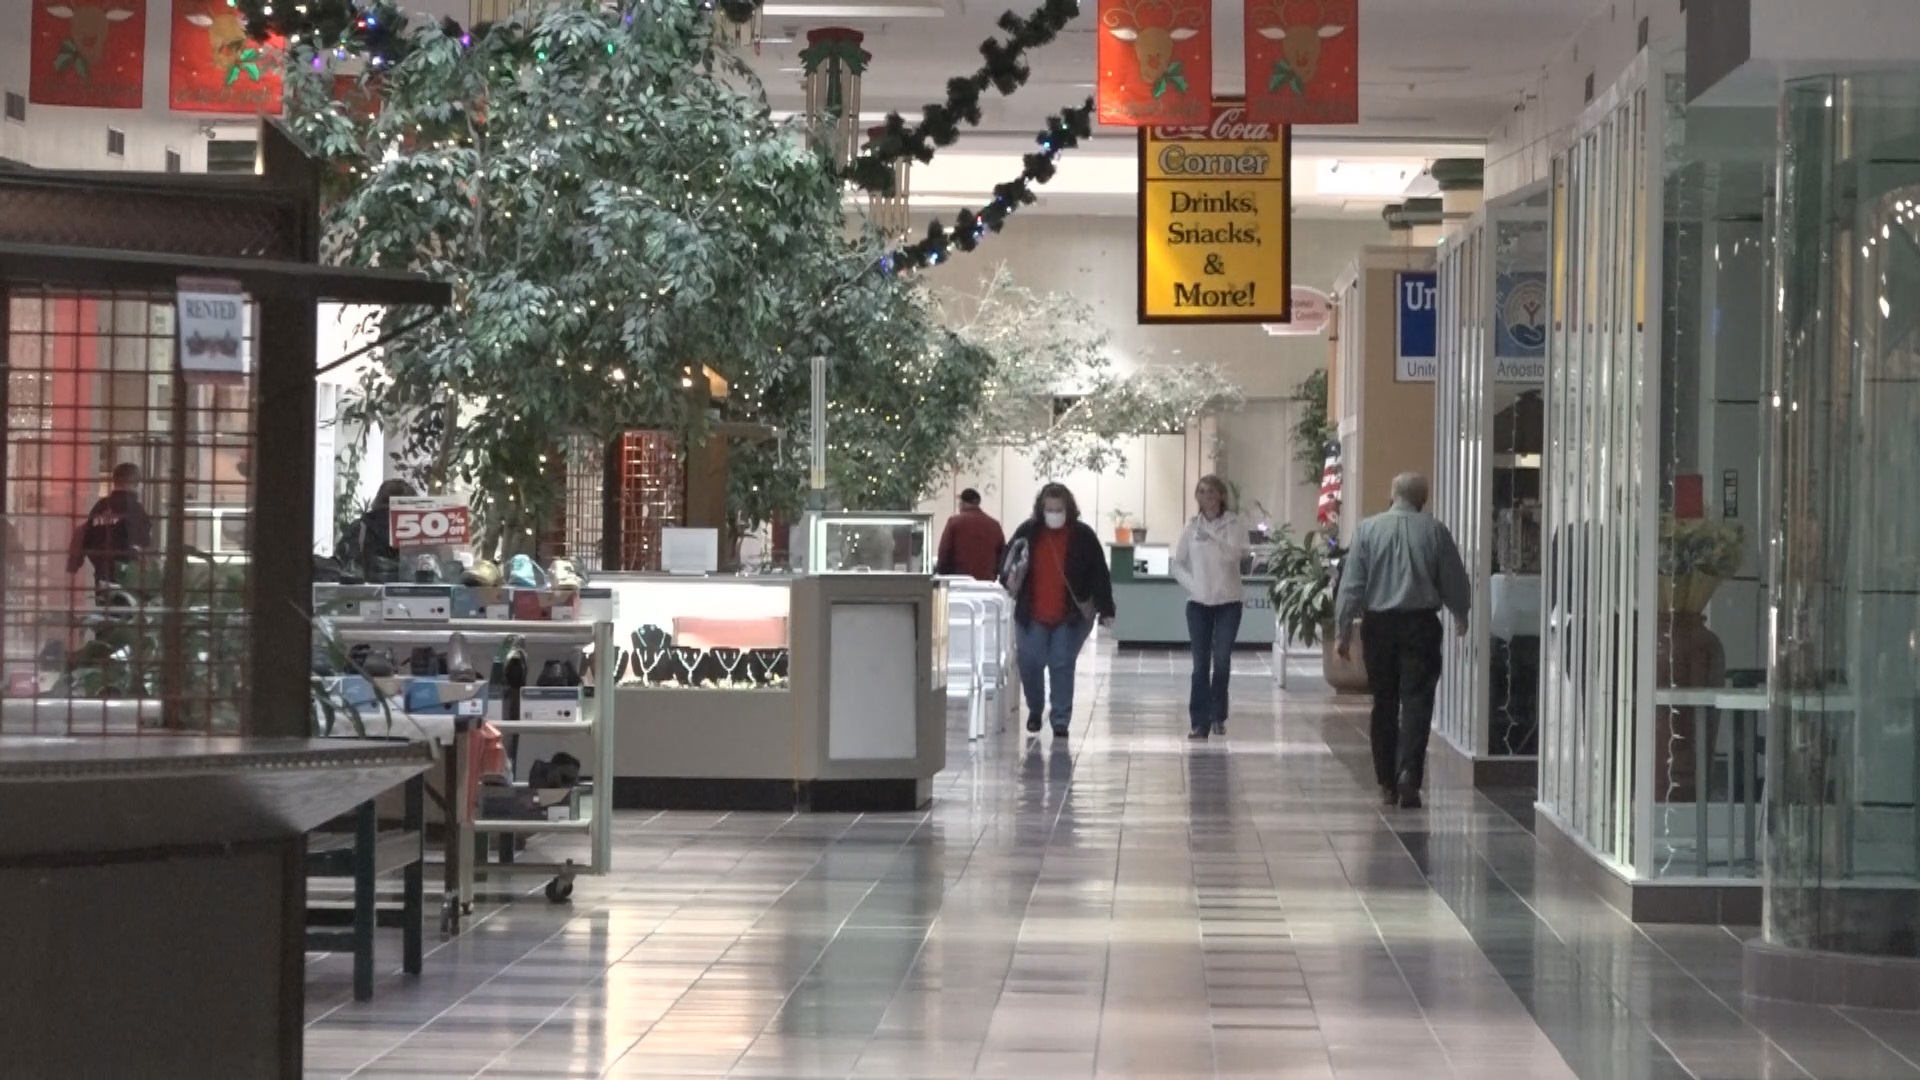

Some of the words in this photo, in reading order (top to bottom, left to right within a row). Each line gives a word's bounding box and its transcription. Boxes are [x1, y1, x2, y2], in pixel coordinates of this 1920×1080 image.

[1159, 144, 1269, 175] Corner
[1170, 190, 1258, 215] Drinks,
[1168, 222, 1261, 247] Snacks,
[1203, 253, 1225, 275] &
[1174, 282, 1256, 308] More!
[185, 299, 236, 320] RENTED
[448, 526, 466, 535] OFF
